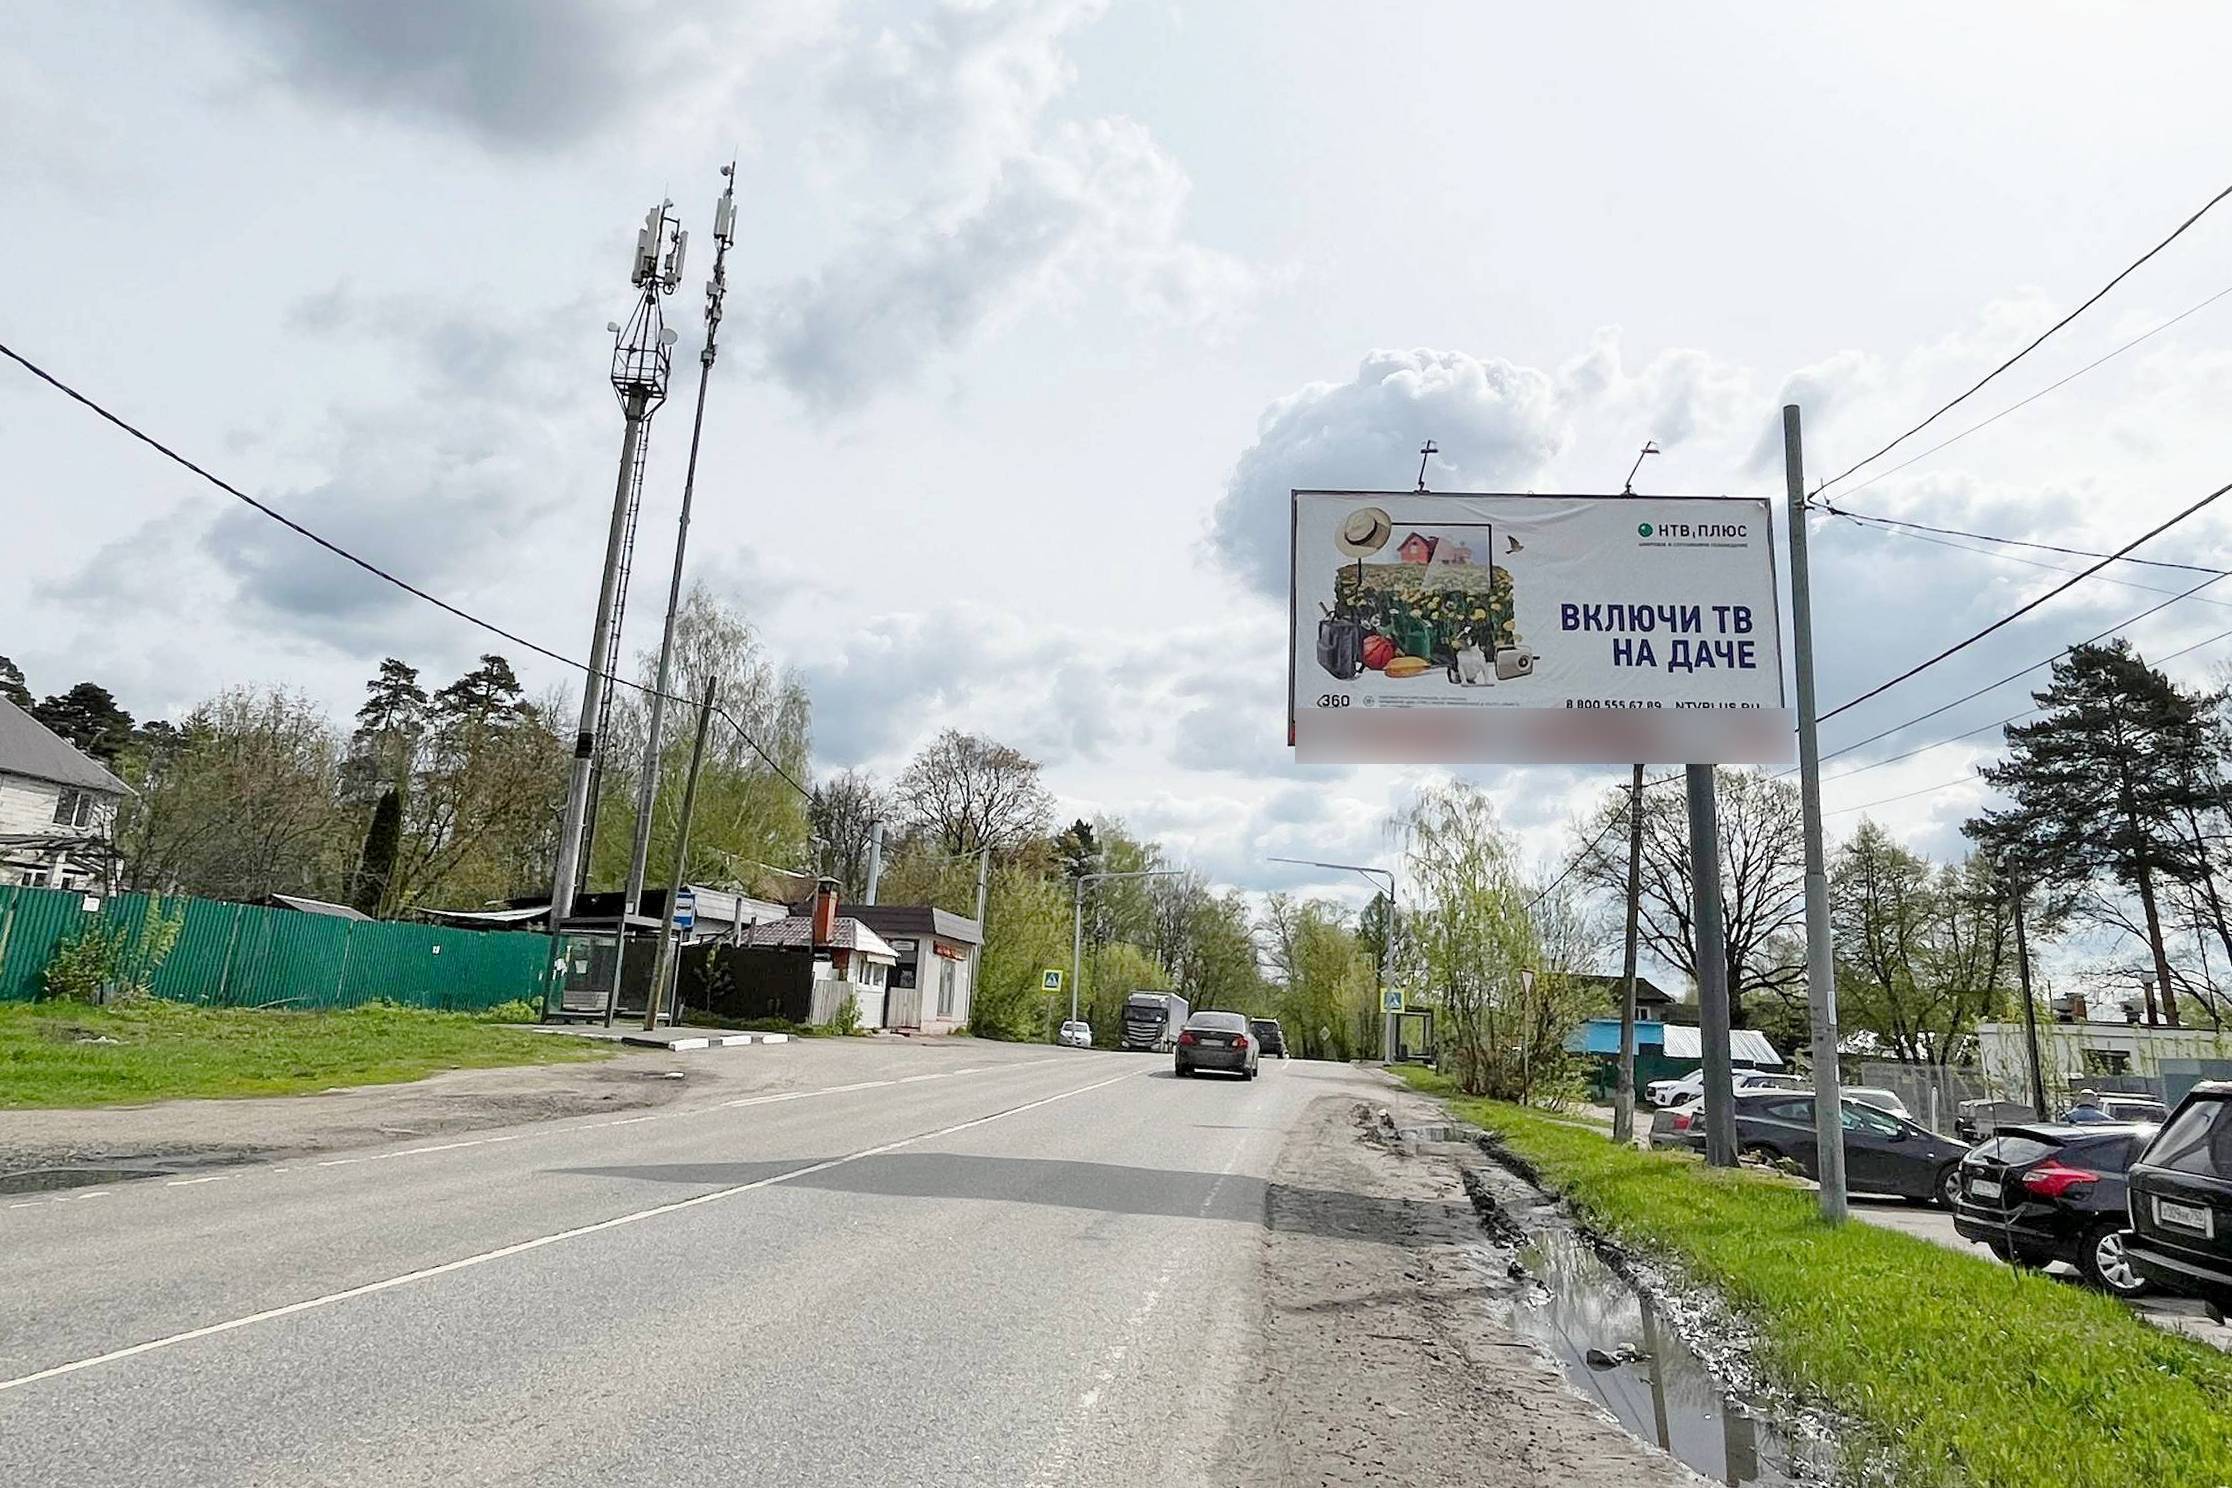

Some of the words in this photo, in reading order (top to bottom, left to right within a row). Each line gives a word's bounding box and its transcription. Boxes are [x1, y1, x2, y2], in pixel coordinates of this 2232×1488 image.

[1560, 603, 1702, 633] ВКЛЮЧИ
[1712, 605, 1753, 634] ТВ
[1612, 638, 1658, 667] НА
[1667, 639, 1757, 673] ДАЧЕ
[1577, 699, 1601, 709] 800
